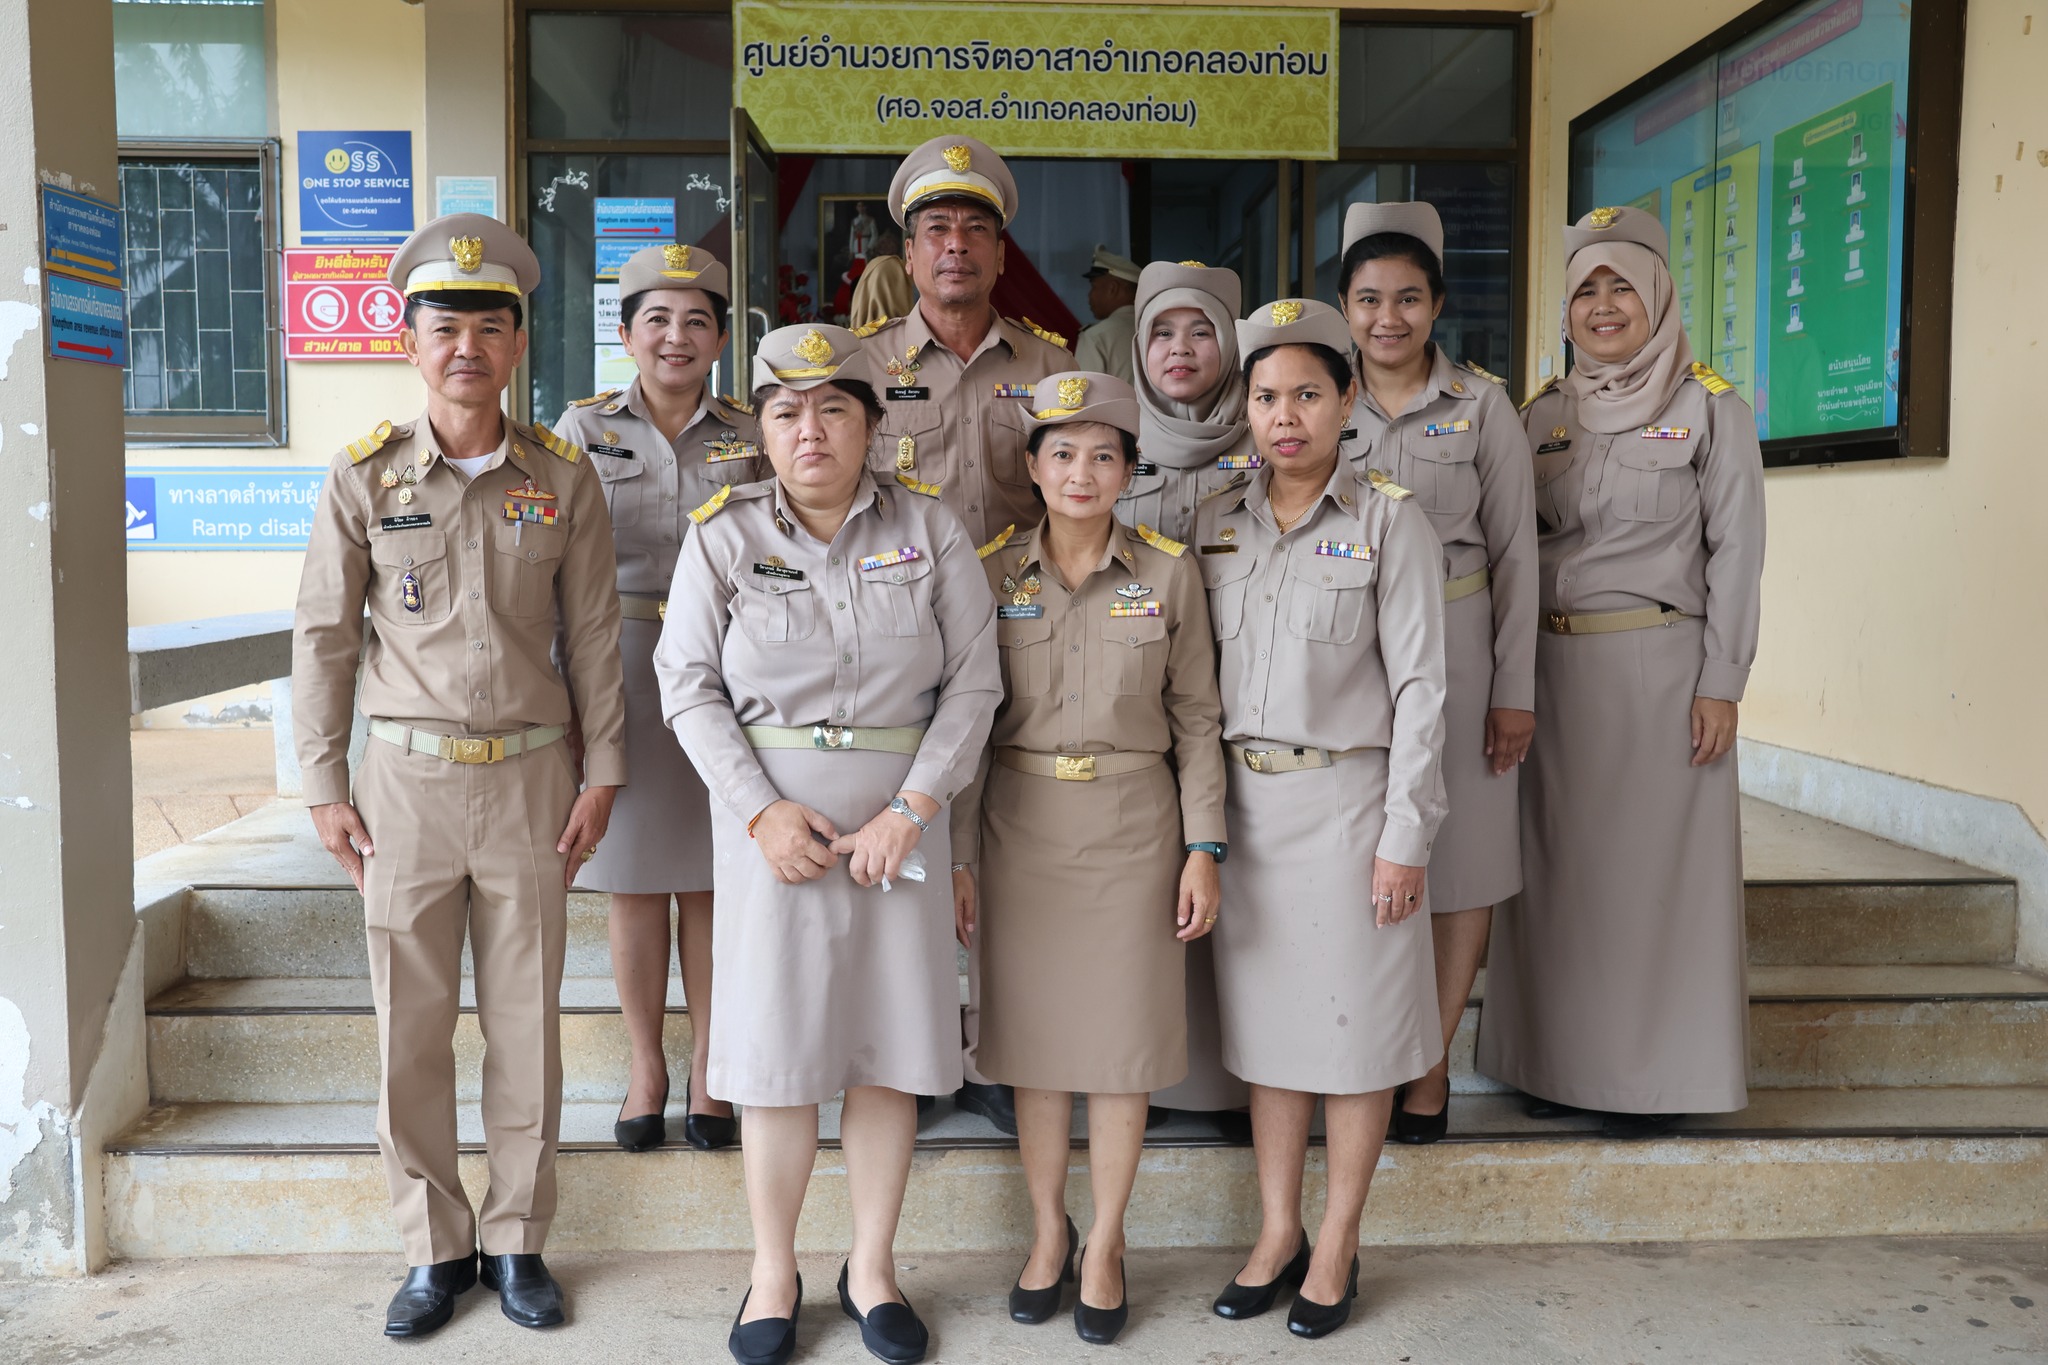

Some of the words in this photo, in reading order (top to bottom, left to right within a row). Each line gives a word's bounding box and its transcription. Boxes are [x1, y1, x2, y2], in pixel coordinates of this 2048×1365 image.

[743, 35, 1328, 77] ศูนย์อำนวยการจิตอาสาอำเภอคลองท่อม
[876, 94, 1198, 128] (ศอ.จอส.อำเภอคลองท่อม)
[303, 177, 330, 189] ONE
[333, 178, 361, 188] STOP
[364, 178, 410, 188] SERVICE
[315, 253, 388, 269] ยินดีต้อนรับ
[169, 481, 321, 512] ทางลาดสำหรับผู้
[193, 518, 251, 540] Ramp
[259, 518, 313, 537] disab
